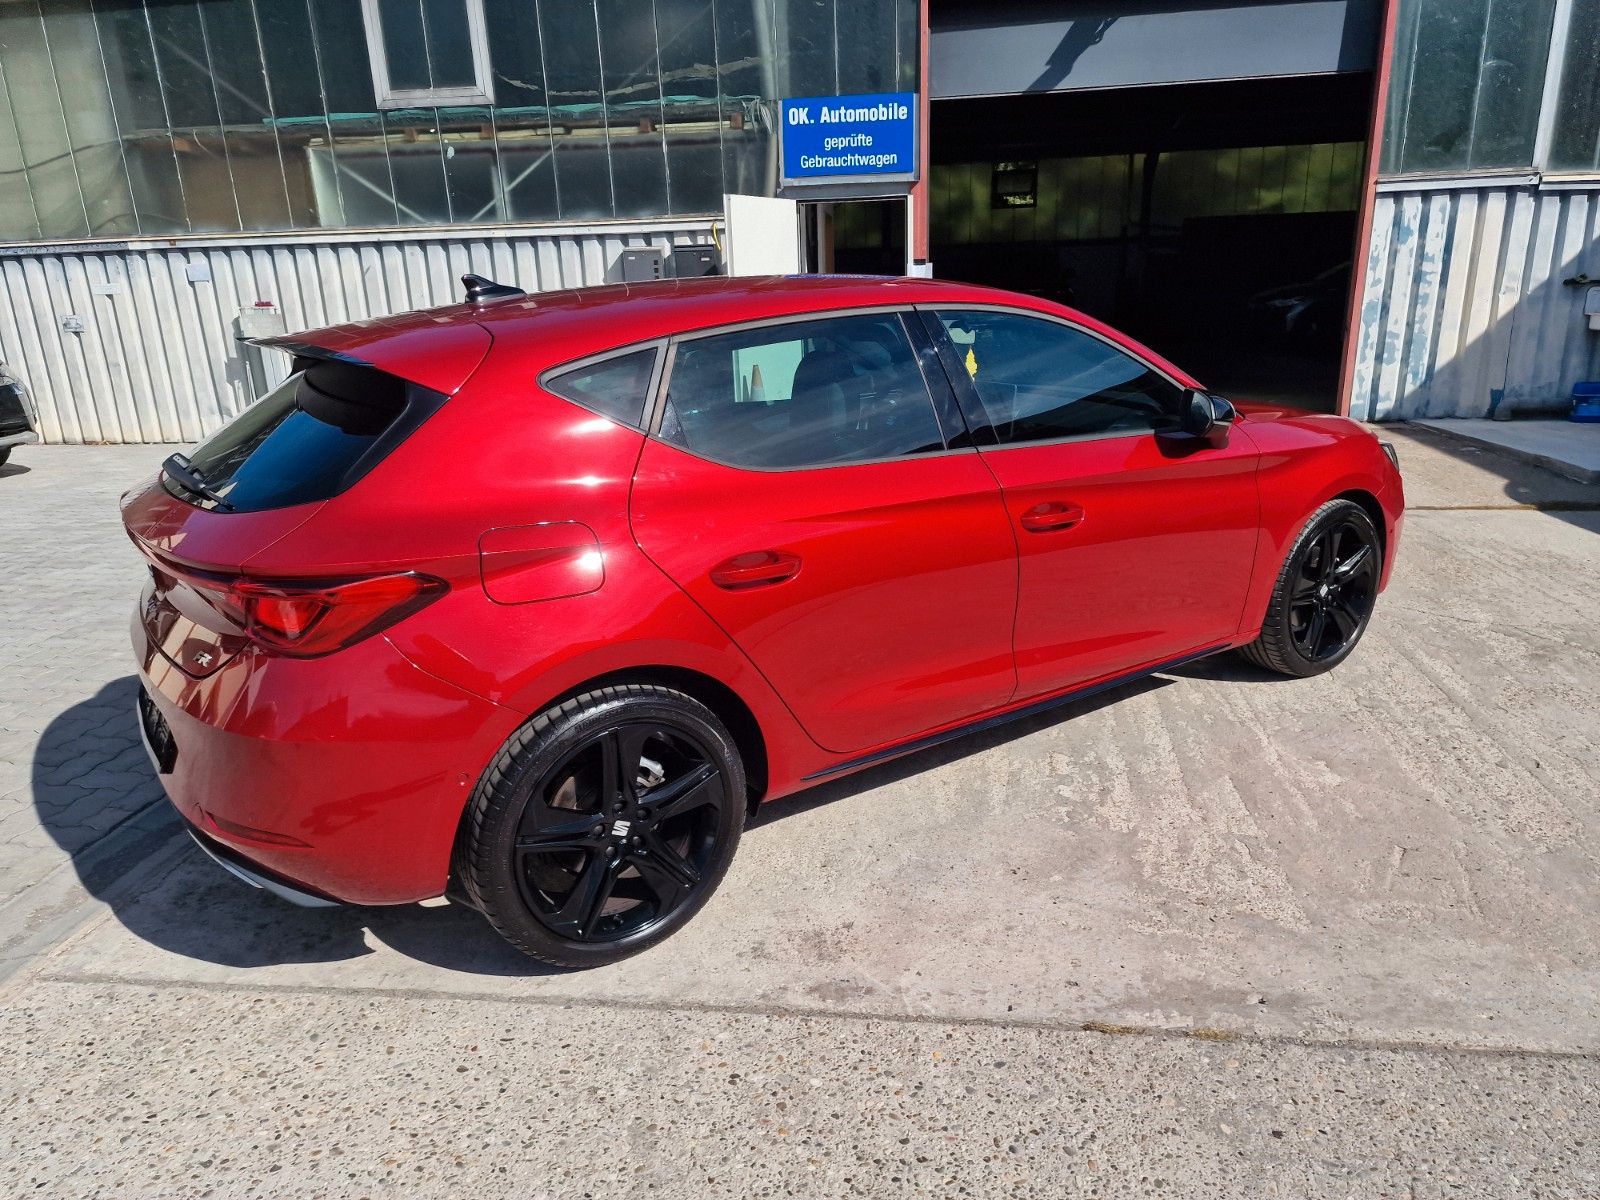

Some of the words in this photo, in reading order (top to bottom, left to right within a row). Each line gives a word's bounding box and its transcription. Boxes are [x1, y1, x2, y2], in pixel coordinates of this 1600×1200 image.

[788, 107, 815, 125] OK.
[820, 102, 908, 124] Automobile
[824, 133, 873, 151] geprüfte
[800, 153, 898, 168] Gebrauchtwagen
